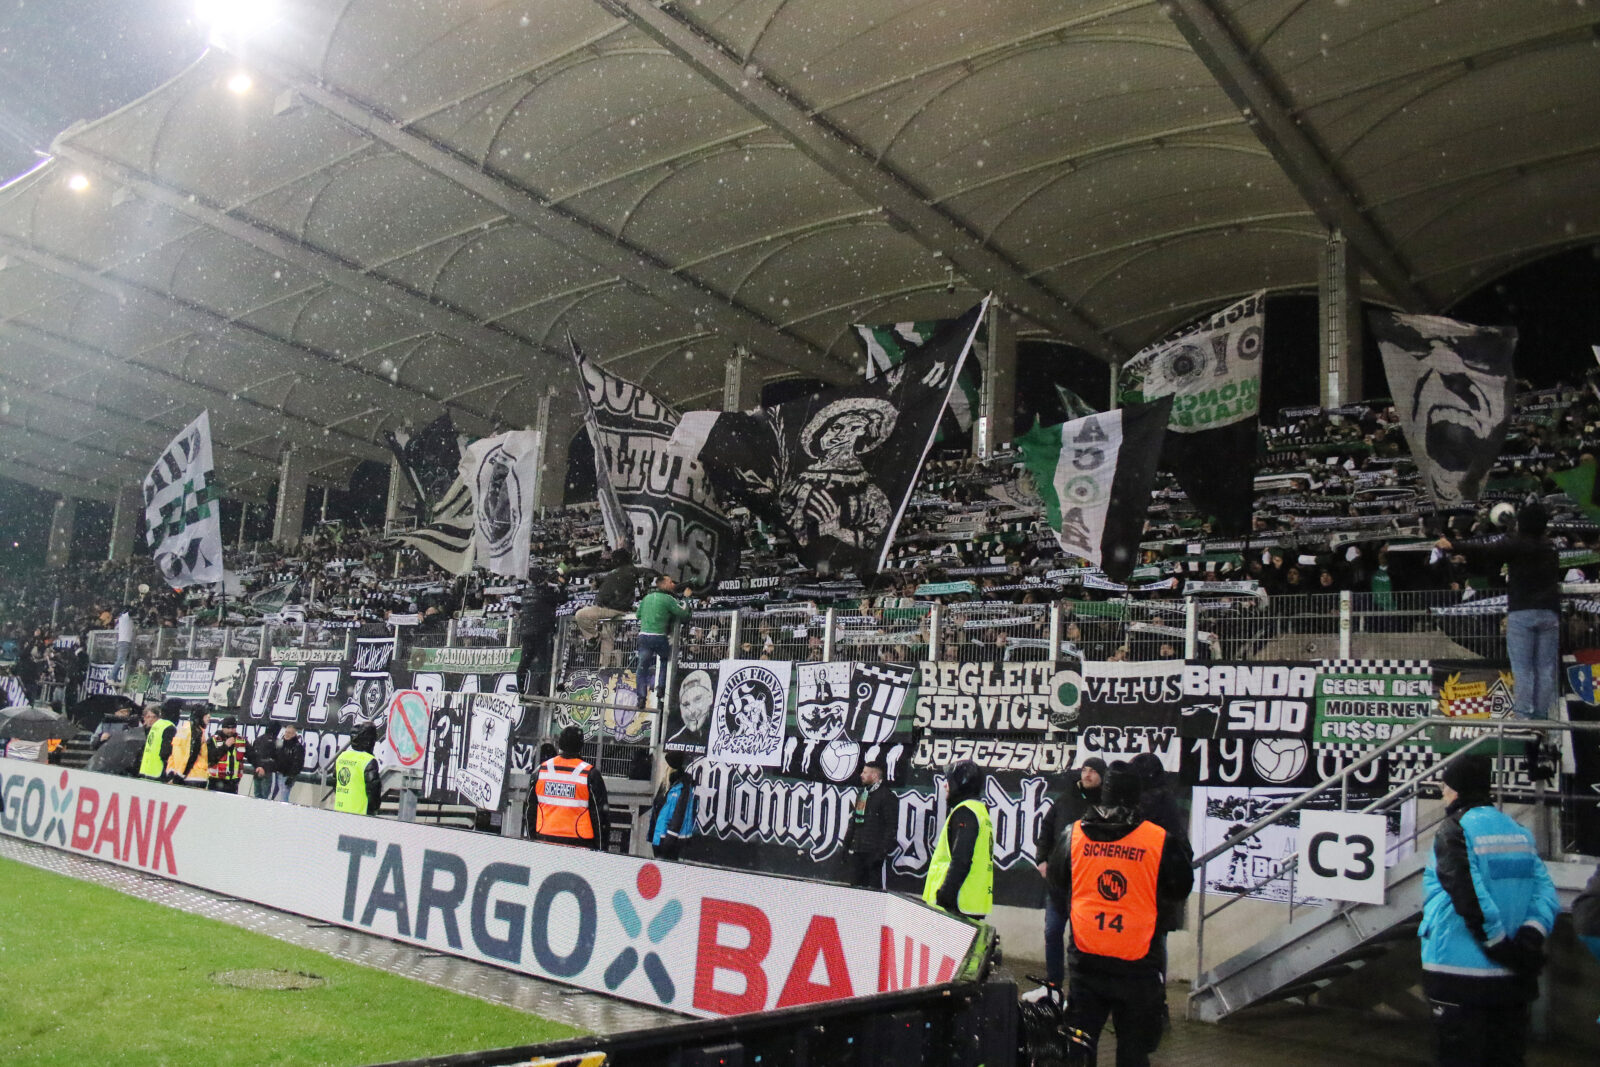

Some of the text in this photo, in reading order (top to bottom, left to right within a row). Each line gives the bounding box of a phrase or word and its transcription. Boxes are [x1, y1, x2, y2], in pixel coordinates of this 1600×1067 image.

[717, 576, 780, 590] NORD KURVE
[272, 650, 344, 662] ASCENDENTE
[435, 649, 514, 666] STADIONVERBOT
[678, 661, 698, 669] IMMER
[918, 661, 1056, 696] BEGLEIT
[1084, 674, 1183, 704] VITUS
[1182, 665, 1317, 698] BANDA
[1321, 678, 1385, 696] GEGEN
[1391, 679, 1433, 696] DEN
[475, 693, 512, 720] GRUNDGESETZ
[913, 695, 1050, 730] SERVICE
[1227, 700, 1308, 733] SUD
[1324, 701, 1432, 719] MODERNEN
[1083, 725, 1177, 754] CREW
[545, 781, 576, 799] SICHERHEIT
[71, 786, 187, 877] BANK
[1083, 843, 1146, 863] SICHERHEIT
[1307, 830, 1376, 882] C3
[337, 834, 598, 981] TARGO
[1094, 911, 1124, 933] 14
